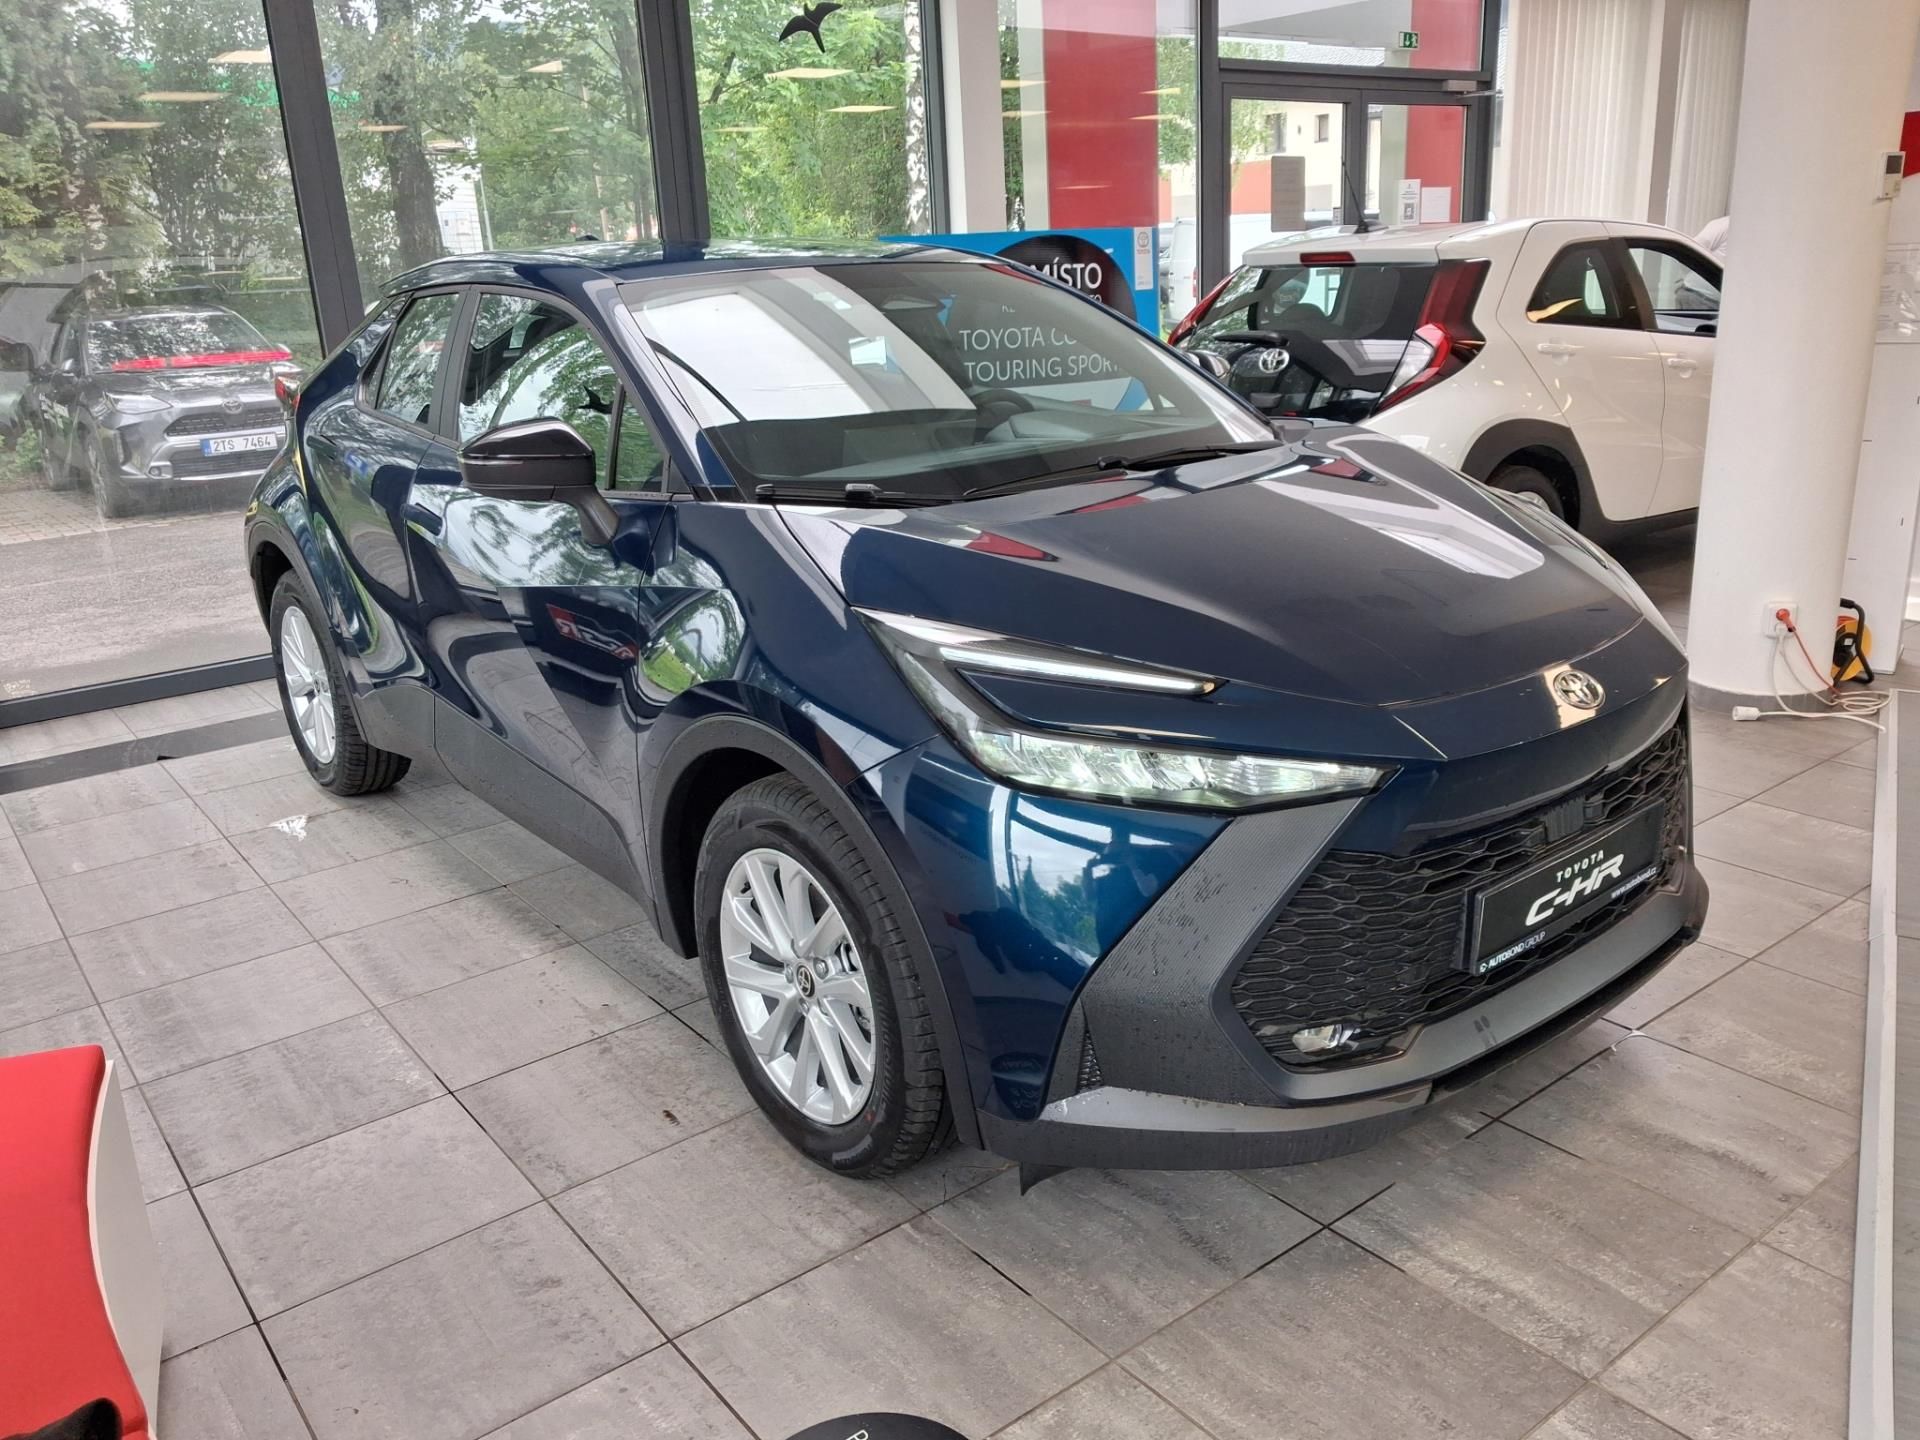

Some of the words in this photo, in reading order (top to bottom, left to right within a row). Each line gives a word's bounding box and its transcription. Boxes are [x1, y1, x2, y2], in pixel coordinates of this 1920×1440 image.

[959, 327, 1045, 350] TOYOTA
[964, 357, 1062, 382] TOURING
[1068, 353, 1118, 376] SPOR
[213, 439, 235, 452] 2TS
[243, 436, 271, 449] 7464
[1556, 849, 1604, 882] TOYOTA
[1525, 854, 1624, 926] C-HR
[1488, 942, 1524, 969] AUTOBOND
